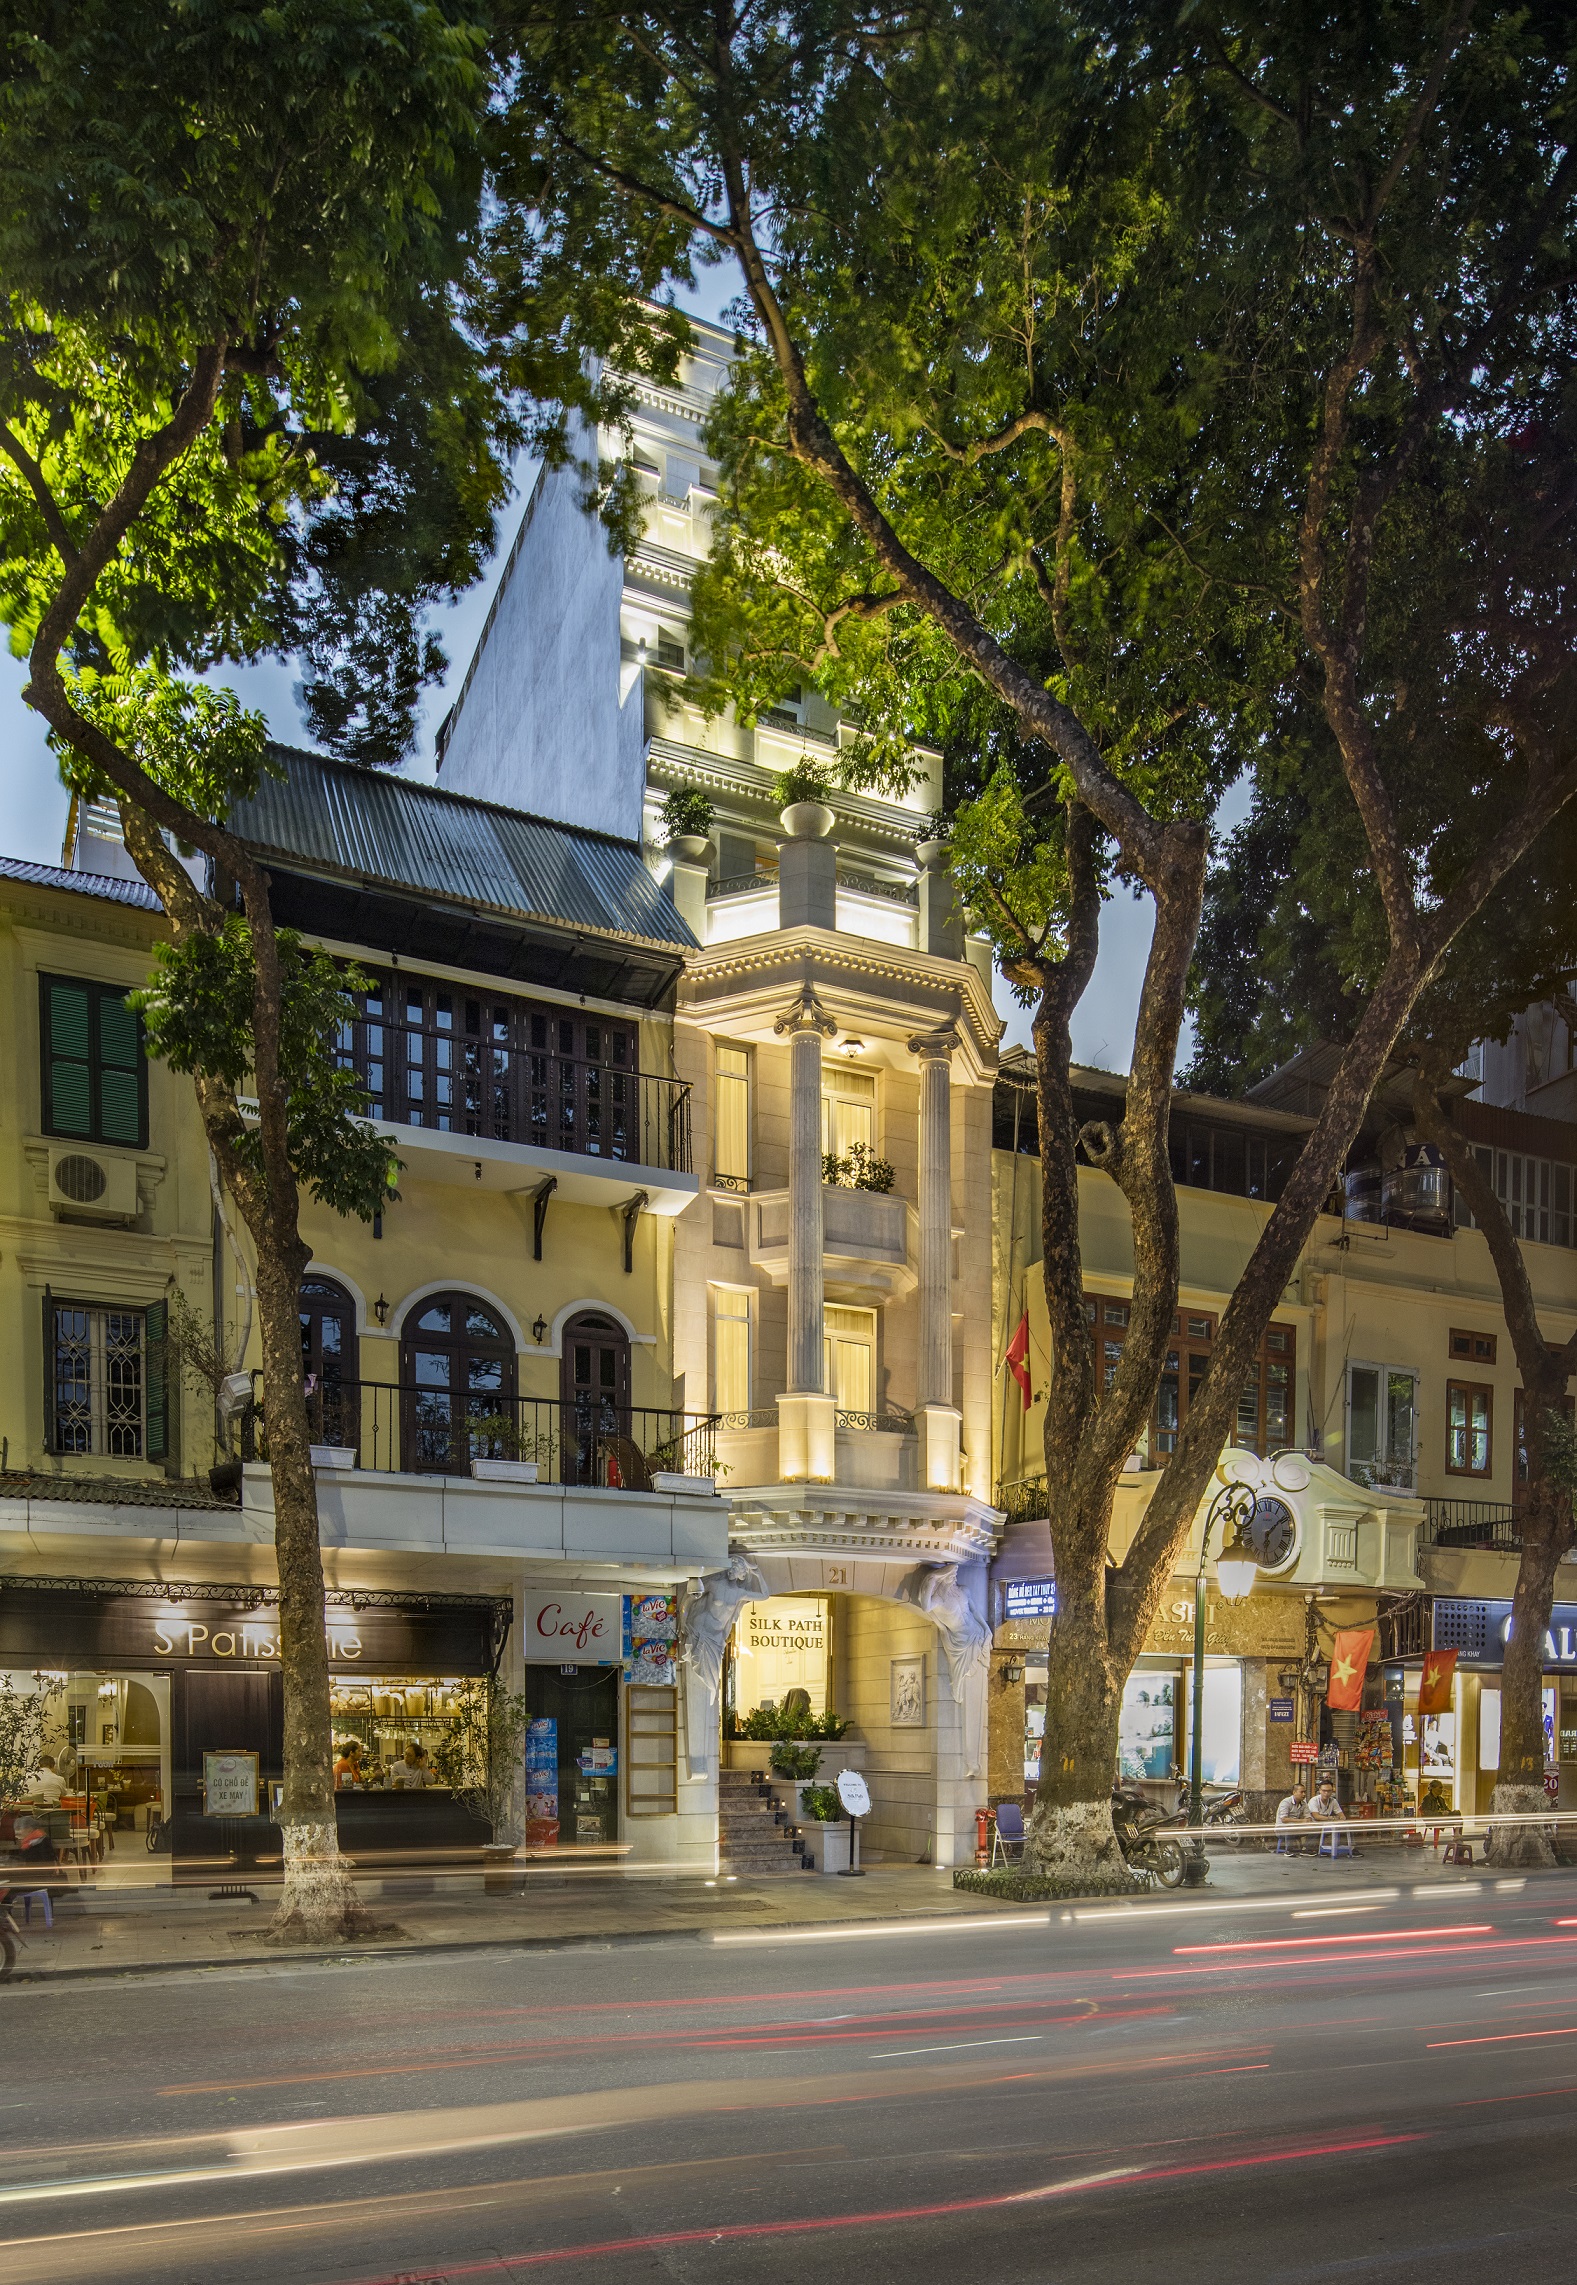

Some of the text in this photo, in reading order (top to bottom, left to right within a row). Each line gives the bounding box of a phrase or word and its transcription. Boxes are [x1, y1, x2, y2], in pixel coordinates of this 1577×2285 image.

[829, 1567, 848, 1584] 21
[537, 1603, 609, 1649] Café
[750, 1618, 822, 1631] SILK PATH
[154, 1624, 363, 1659] S Patisie
[751, 1635, 824, 1650] BOUTIQUE
[564, 1664, 574, 1673] 19
[213, 1777, 222, 1787] CÓ
[218, 1792, 228, 1800] XE
